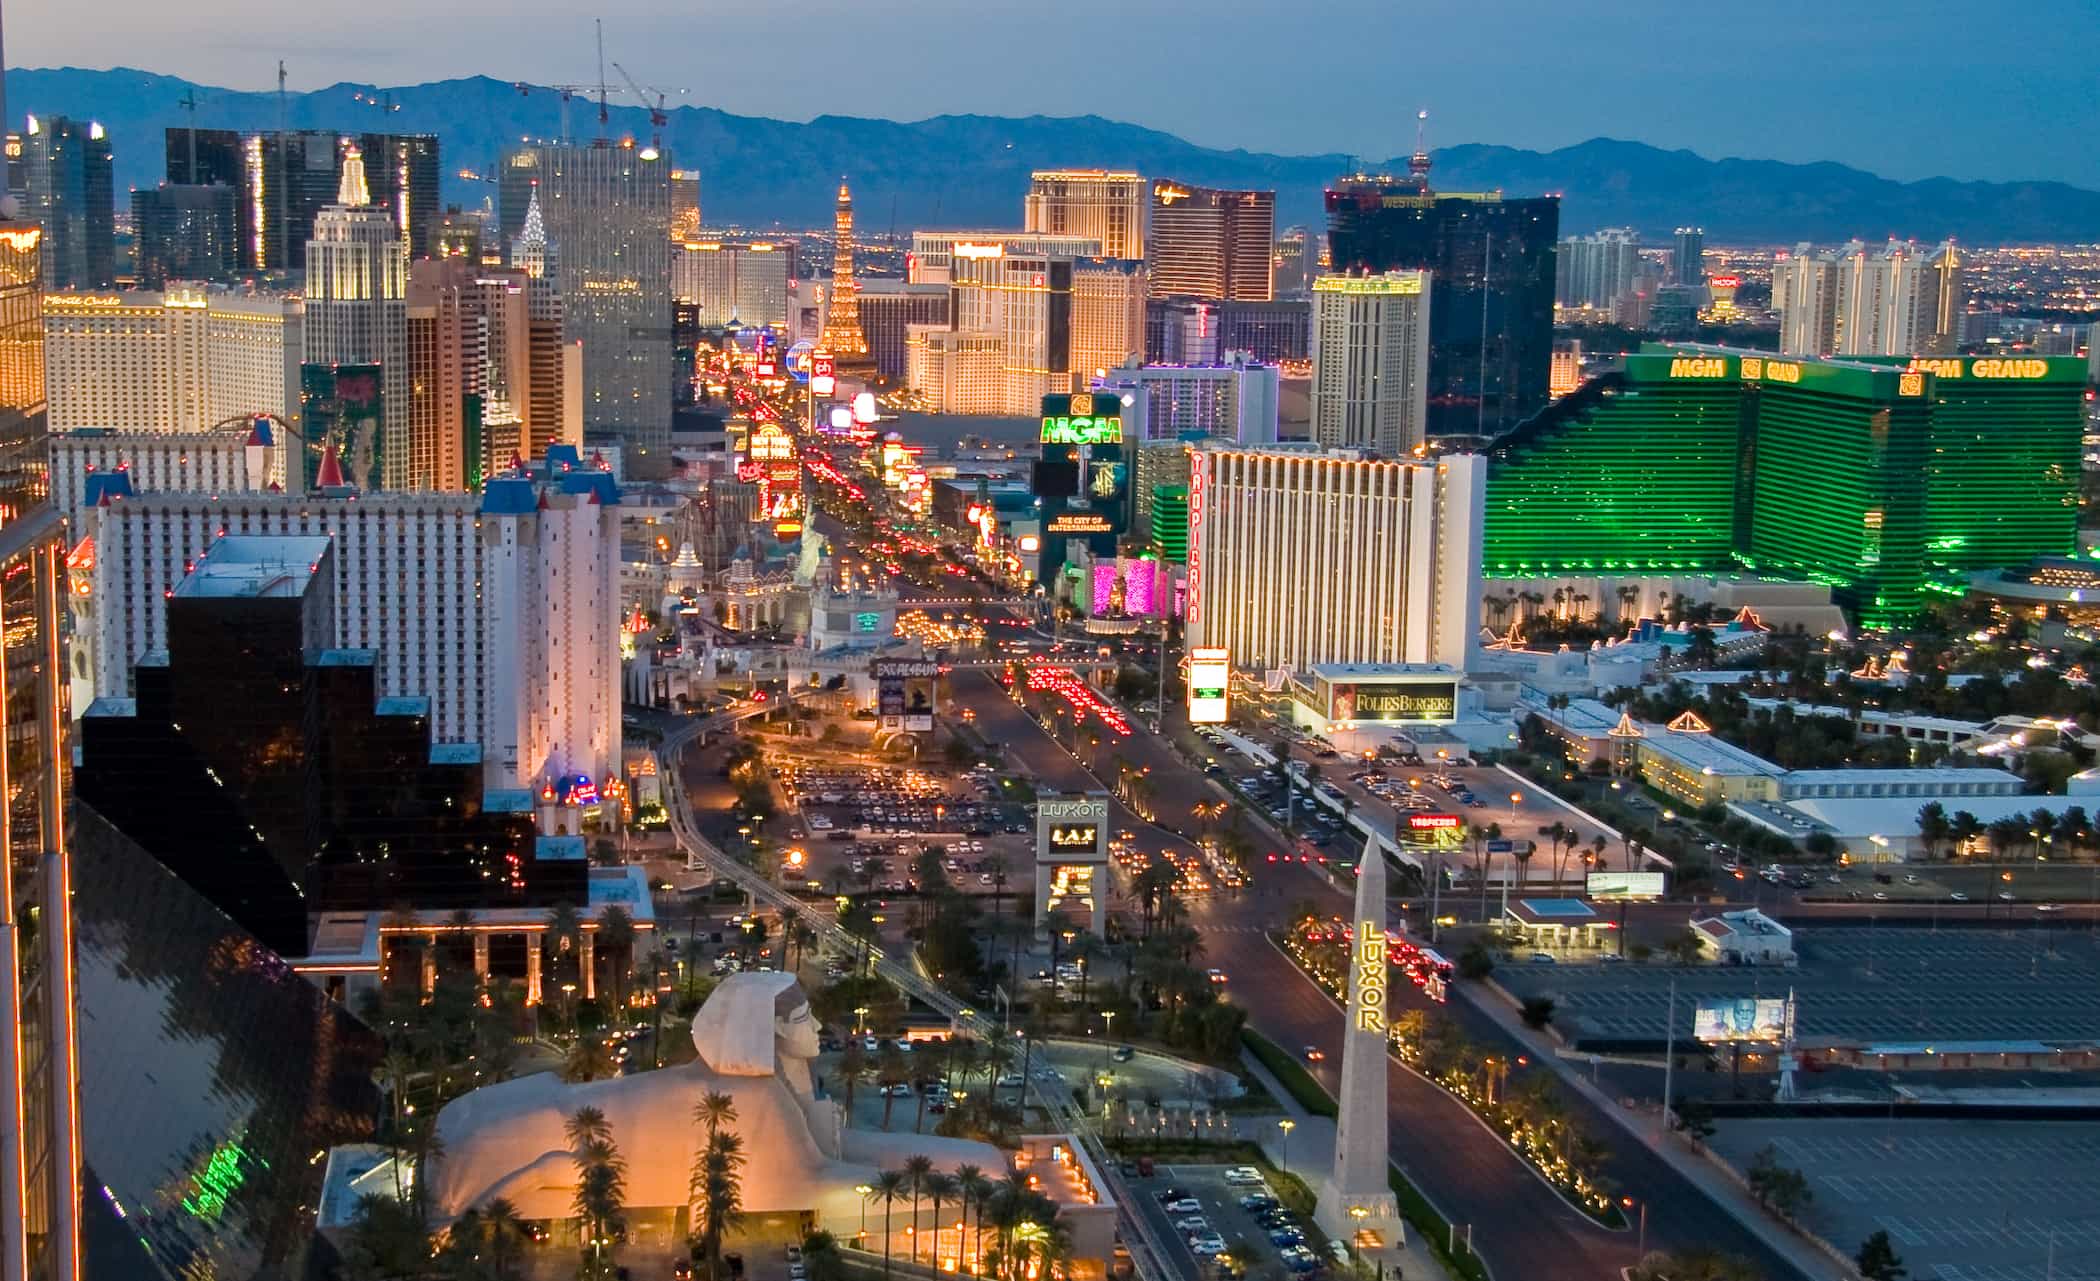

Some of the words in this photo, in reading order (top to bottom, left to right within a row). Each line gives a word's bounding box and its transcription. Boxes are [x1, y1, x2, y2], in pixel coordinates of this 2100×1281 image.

[1382, 197, 1436, 209] WESTGATE
[43, 295, 83, 306] Monte
[84, 296, 120, 306] Carlo
[1670, 359, 1724, 378] MGM
[1766, 361, 1799, 383] GRAND
[1971, 359, 2048, 378] GRAND
[1040, 417, 1123, 444] MGM
[1057, 516, 1073, 524] THE
[1073, 516, 1091, 524] CITY
[1091, 516, 1103, 524] OF
[1047, 524, 1112, 532] ENTERTAINMENT
[1188, 453, 1204, 624] TROPICANA
[877, 663, 938, 677] EXCALIBUR
[1040, 803, 1107, 817] LUXOR
[1052, 829, 1095, 842] LAX
[1358, 921, 1386, 1032] LUXOR
